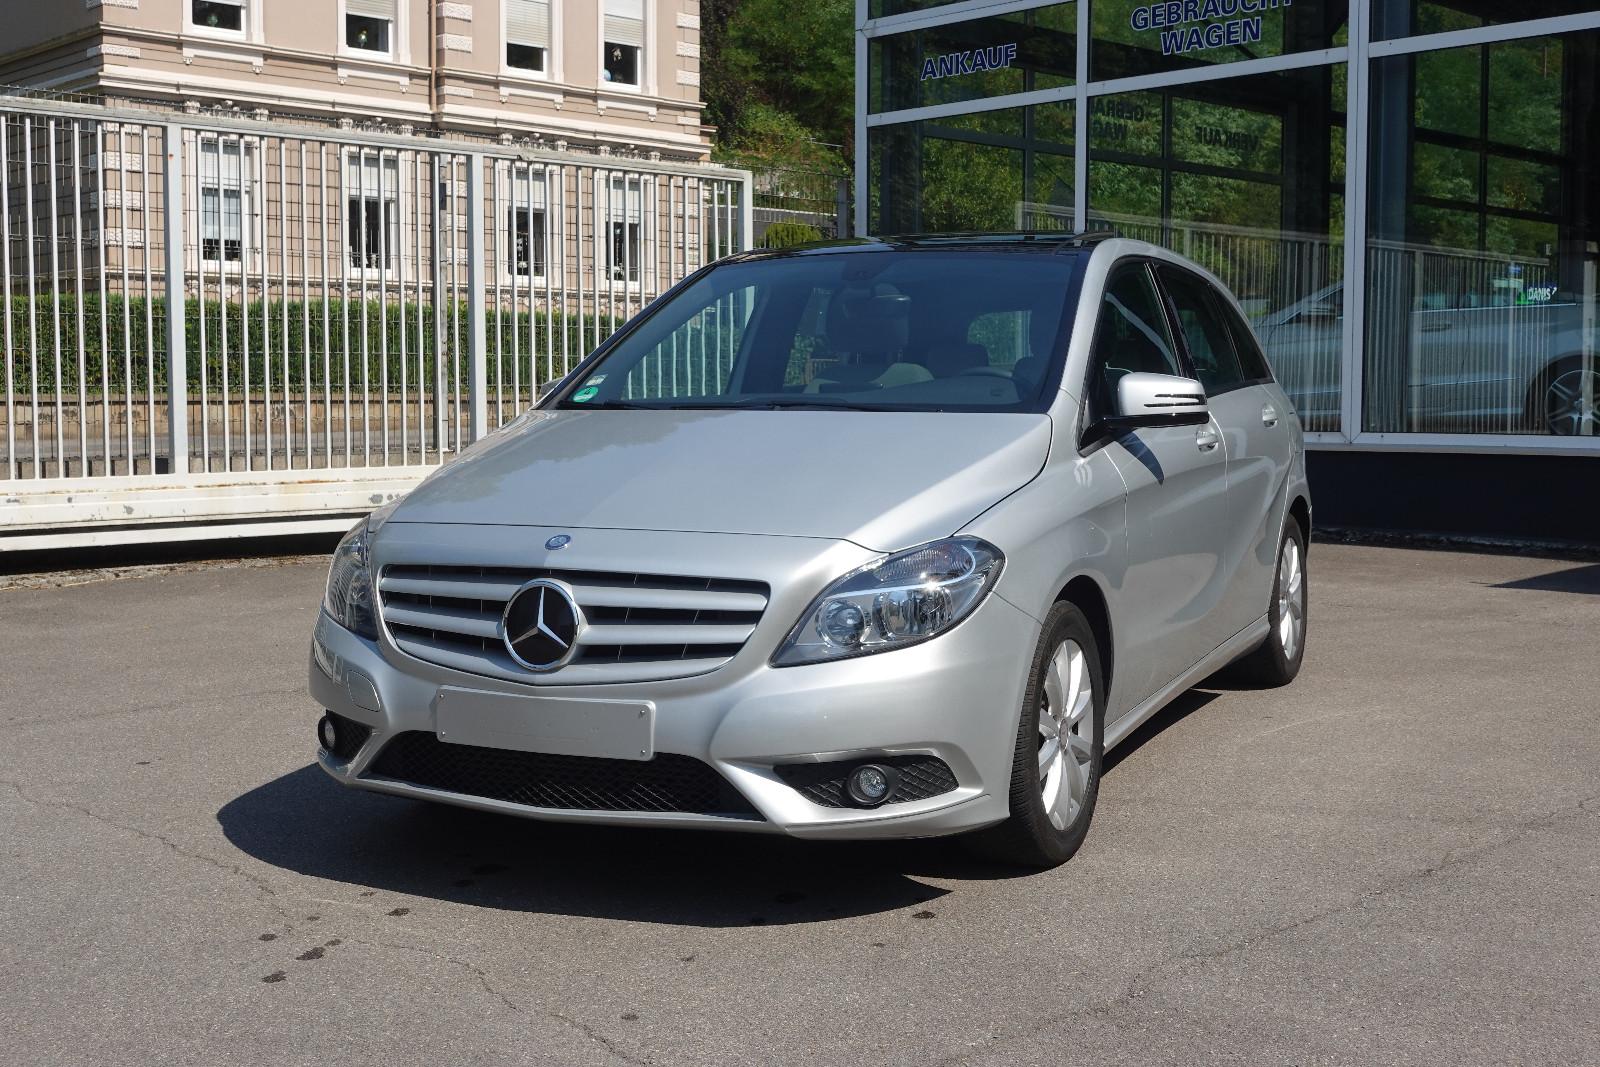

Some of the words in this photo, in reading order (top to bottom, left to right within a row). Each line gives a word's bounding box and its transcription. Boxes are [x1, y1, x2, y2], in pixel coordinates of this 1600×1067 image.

[1131, 0, 1292, 30] GEBRAUC
[1160, 17, 1262, 55] WAGEN
[920, 43, 1016, 81] ANKAUF
